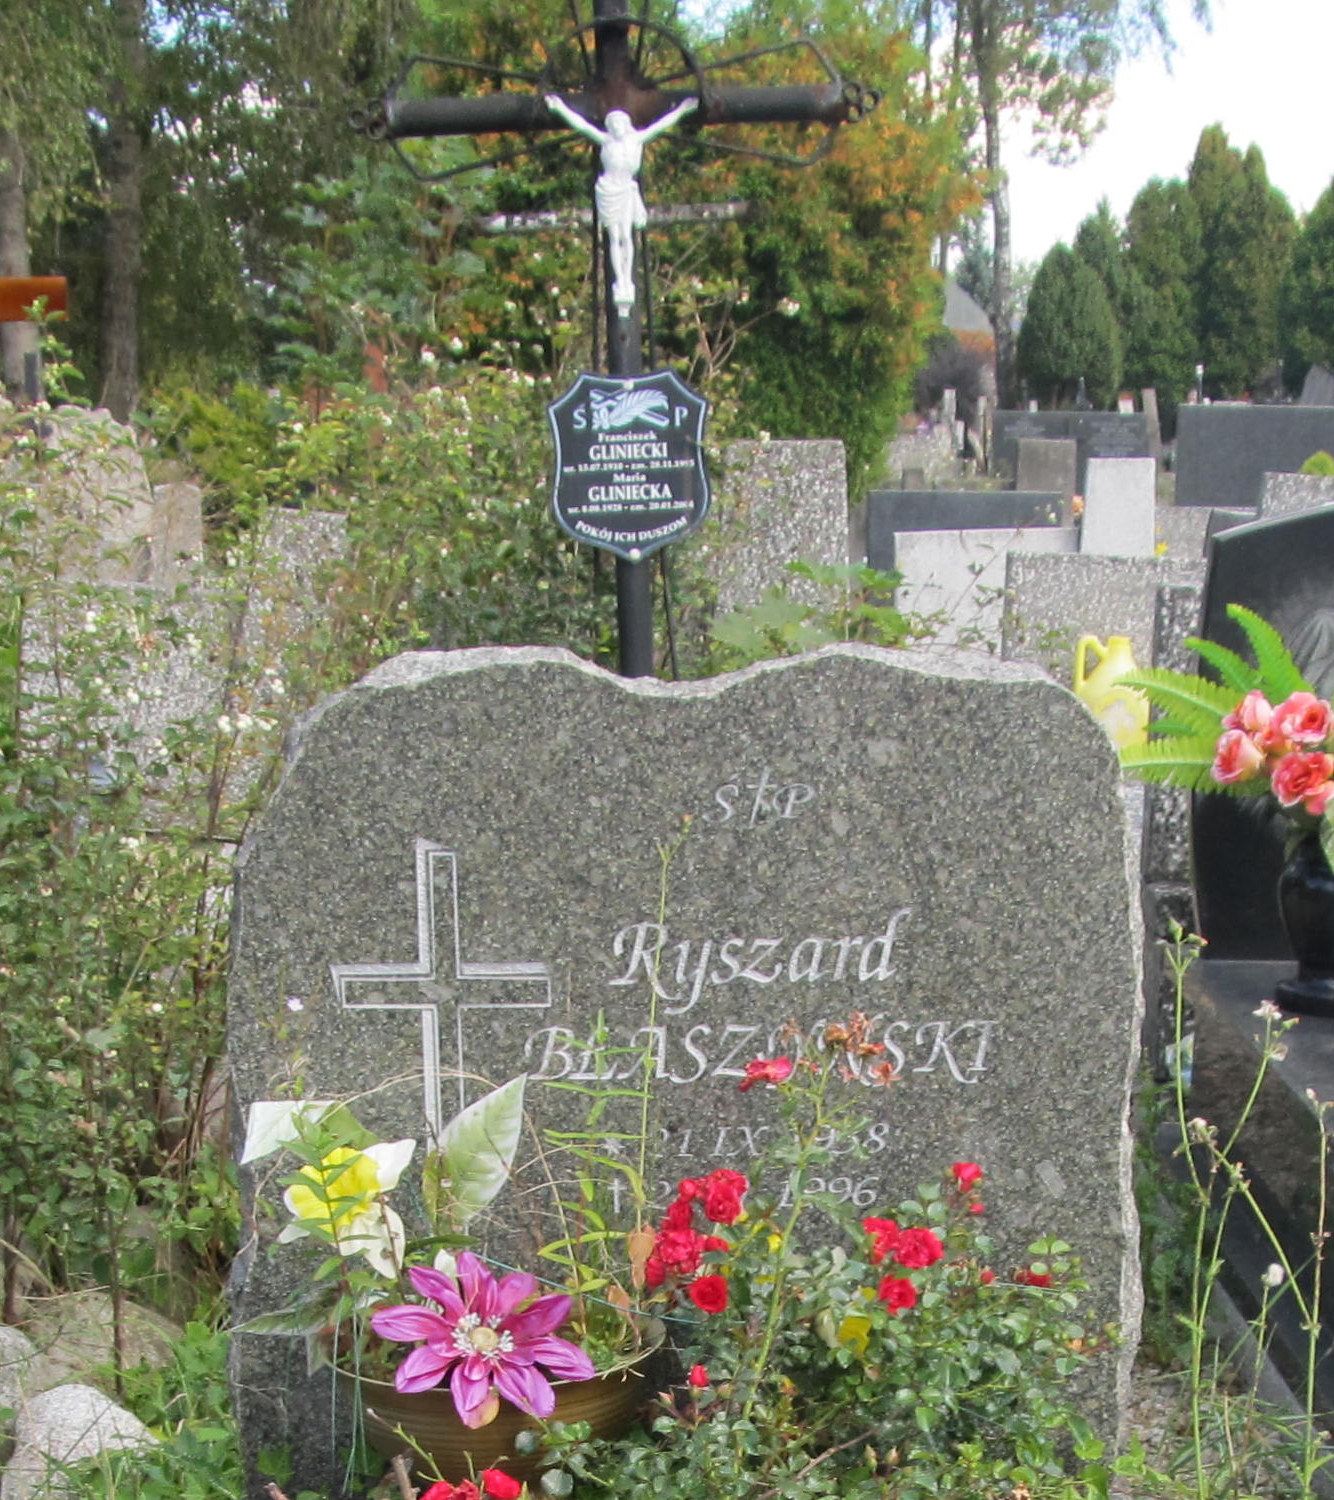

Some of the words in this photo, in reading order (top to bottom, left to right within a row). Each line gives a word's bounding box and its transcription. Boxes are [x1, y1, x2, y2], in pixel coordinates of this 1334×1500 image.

[597, 430, 657, 443] Franciszek
[588, 442, 669, 461] GLINIECKI
[612, 472, 647, 484] Maria
[588, 483, 673, 503] GLINIECKA
[575, 519, 613, 542] POKÓJ
[614, 530, 637, 542] ICH
[638, 515, 689, 542] DUSZOM
[608, 906, 913, 1016] Ryszard
[709, 1125, 771, 1158] IX
